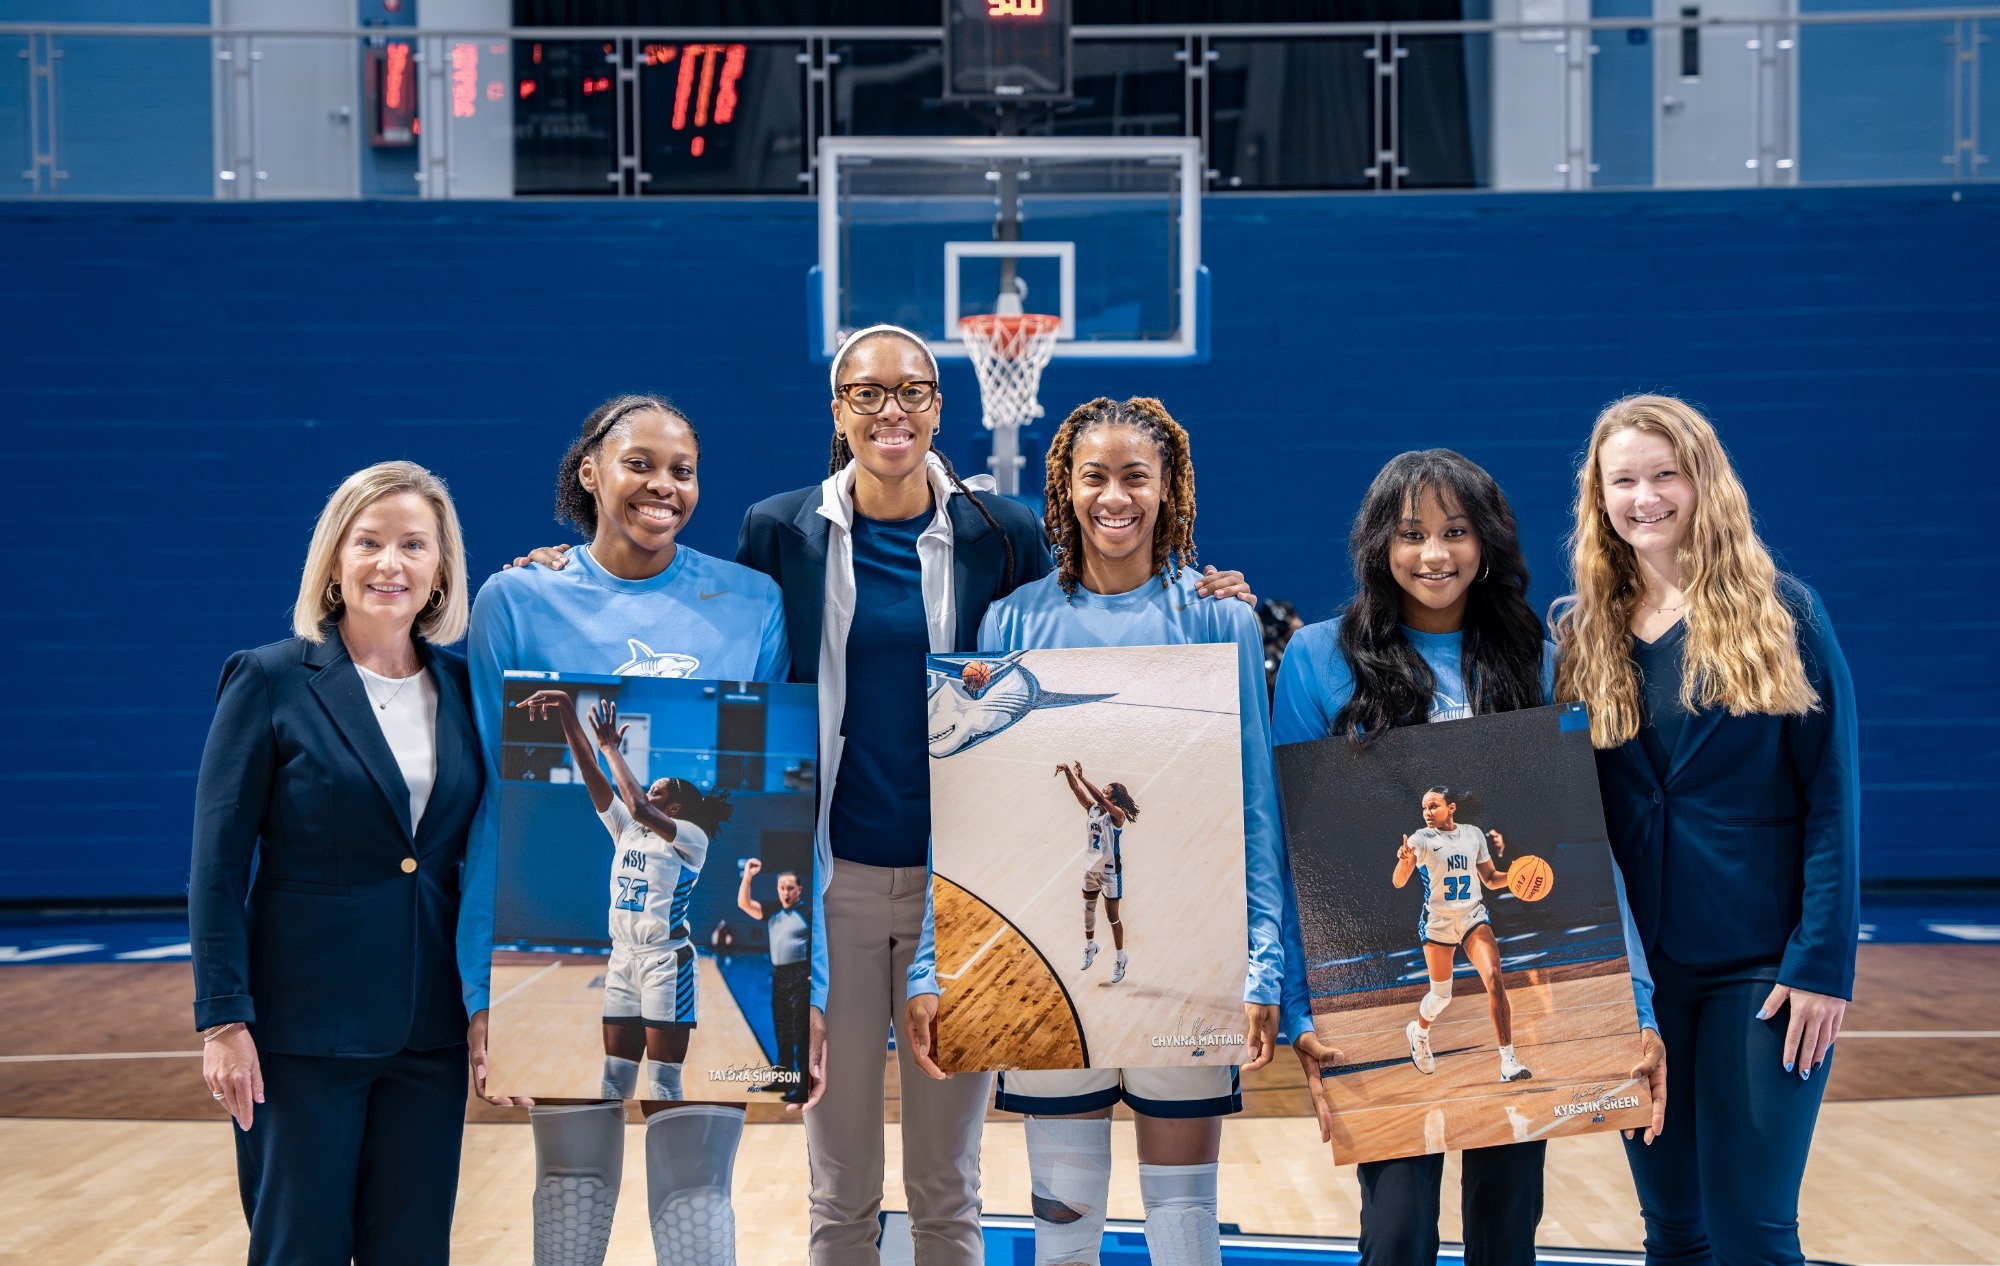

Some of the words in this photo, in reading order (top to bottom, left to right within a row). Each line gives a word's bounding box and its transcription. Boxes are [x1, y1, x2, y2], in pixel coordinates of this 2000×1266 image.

[1093, 834, 1100, 849] 2
[622, 849, 647, 873] NSU
[1447, 854, 1468, 872] NSU
[615, 876, 648, 912] 23
[1444, 875, 1471, 901] 32
[1151, 1036, 1197, 1048] CHYNNA
[1198, 1034, 1245, 1046] MATTAIR
[708, 1069, 750, 1082] TAYDRA
[752, 1071, 801, 1083] SIMPSON
[1553, 1101, 1600, 1117] KYRSTIN
[1603, 1096, 1640, 1111] GREEN
